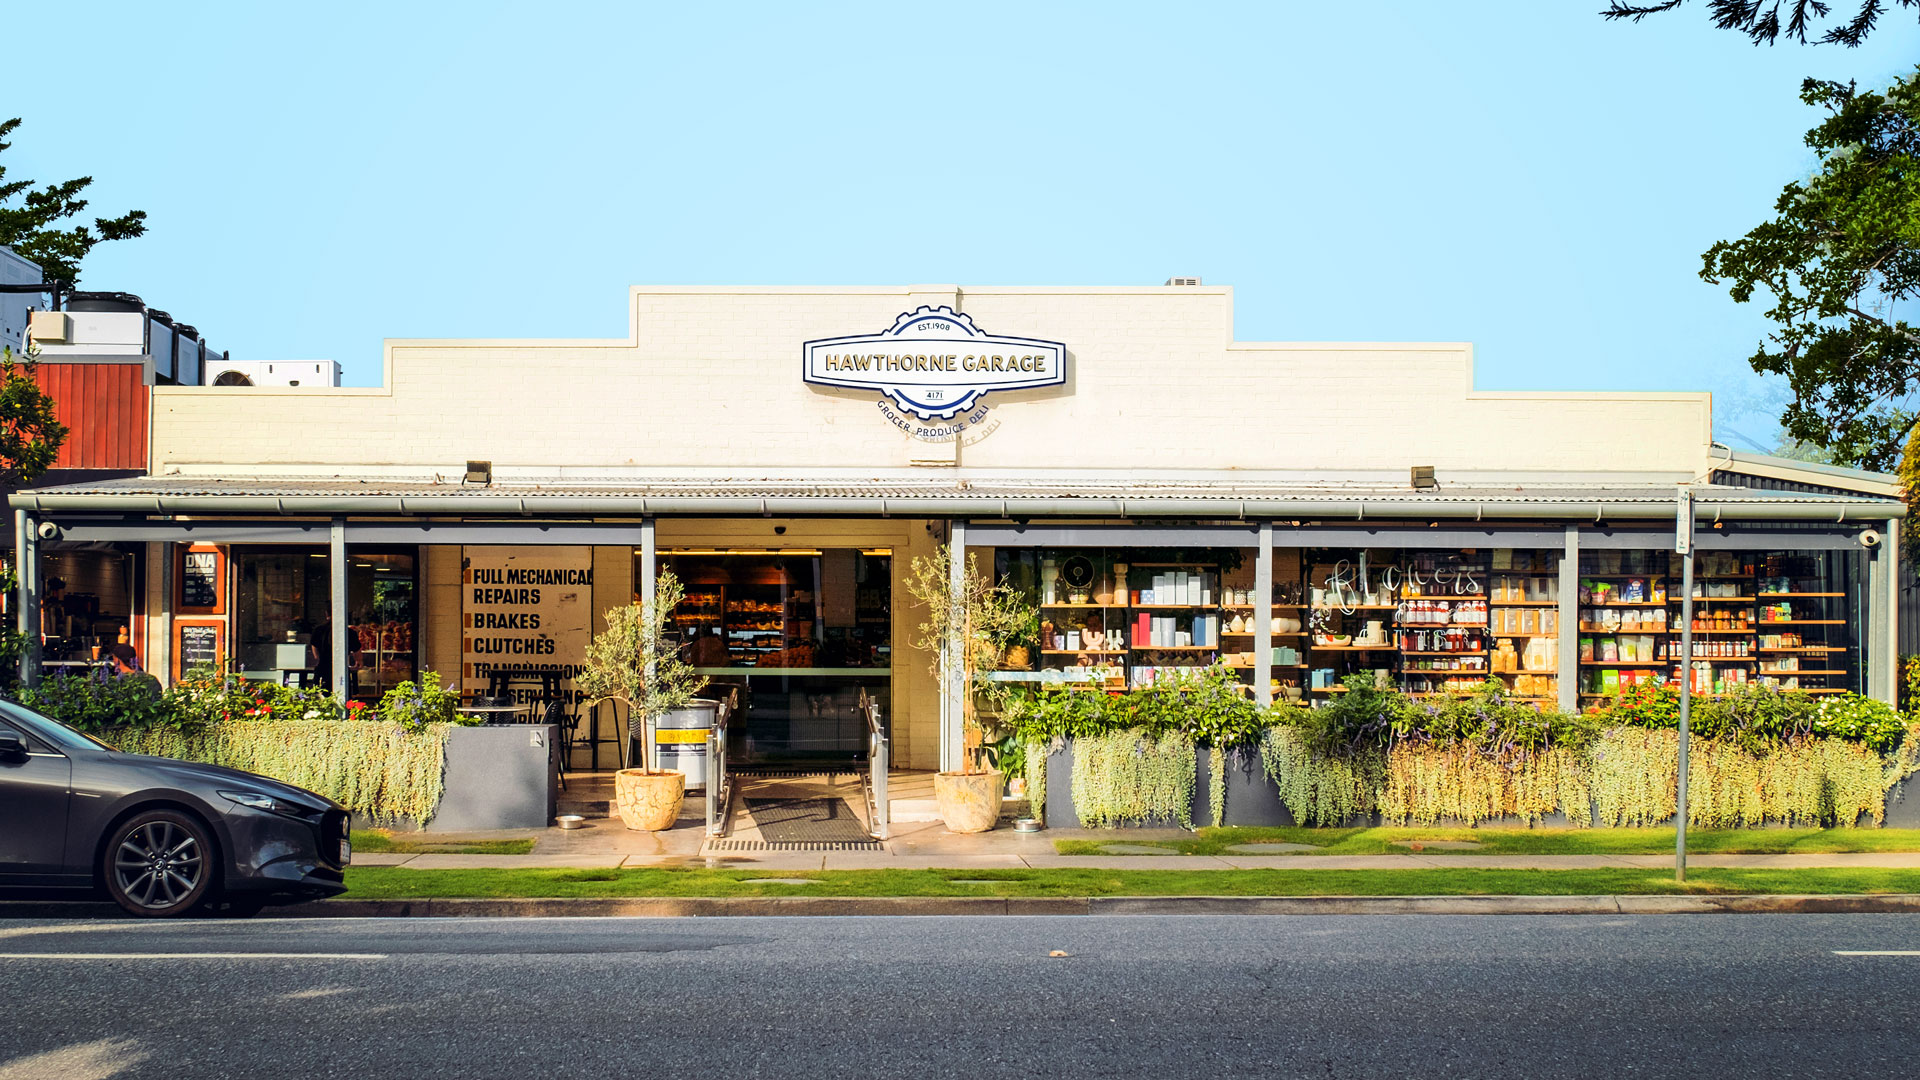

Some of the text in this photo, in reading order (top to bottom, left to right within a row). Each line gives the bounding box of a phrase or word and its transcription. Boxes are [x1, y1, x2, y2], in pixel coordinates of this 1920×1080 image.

[826, 354, 1046, 372] HAWTHORNE GARAGE
[877, 400, 989, 437] GROCER PRODUCE DELI
[185, 554, 216, 568] DNA
[473, 569, 592, 585] FULL MECHANICAL
[473, 588, 541, 604] REPAIRS
[474, 613, 540, 629] BRAKES
[473, 638, 555, 654] CLUTCHES
